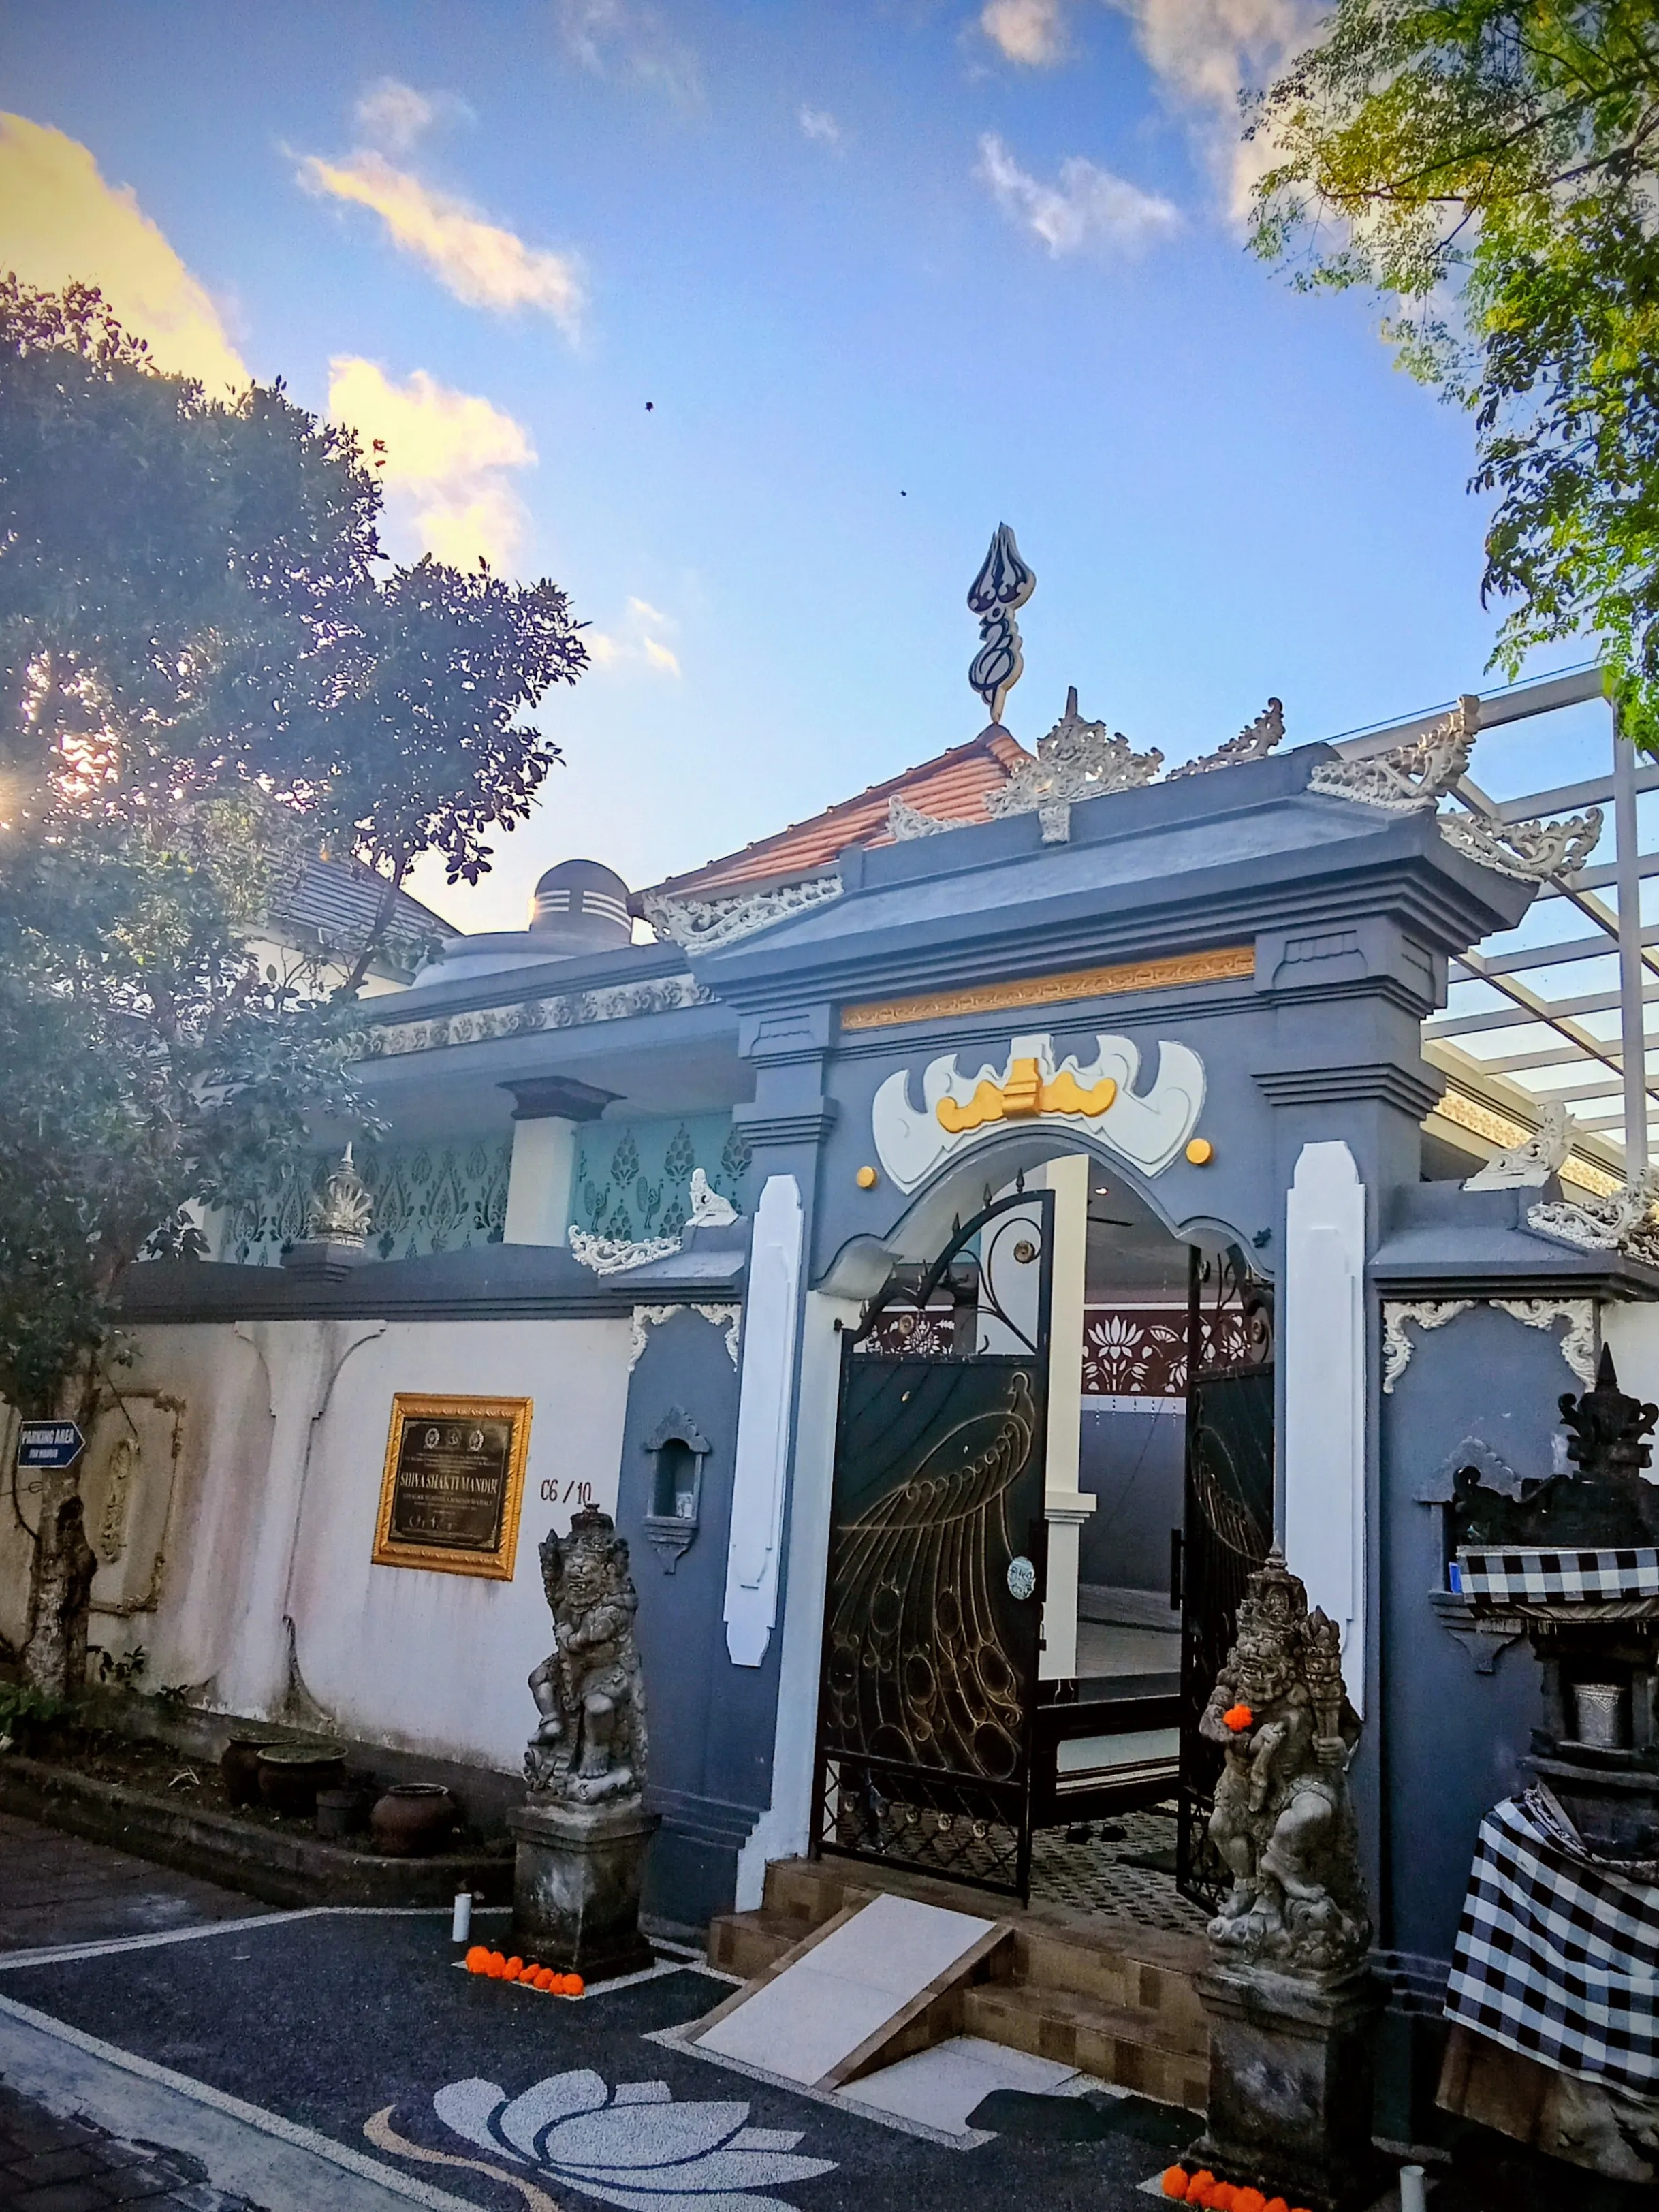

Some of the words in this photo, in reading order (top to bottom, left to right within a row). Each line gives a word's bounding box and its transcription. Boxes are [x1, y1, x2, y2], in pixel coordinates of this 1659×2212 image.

[22, 1429, 54, 1444] PARKING
[54, 1429, 74, 1444] AREA
[399, 1472, 425, 1488] SHIVA
[425, 1474, 461, 1491] SHAKTI
[461, 1476, 499, 1494] MANDIR
